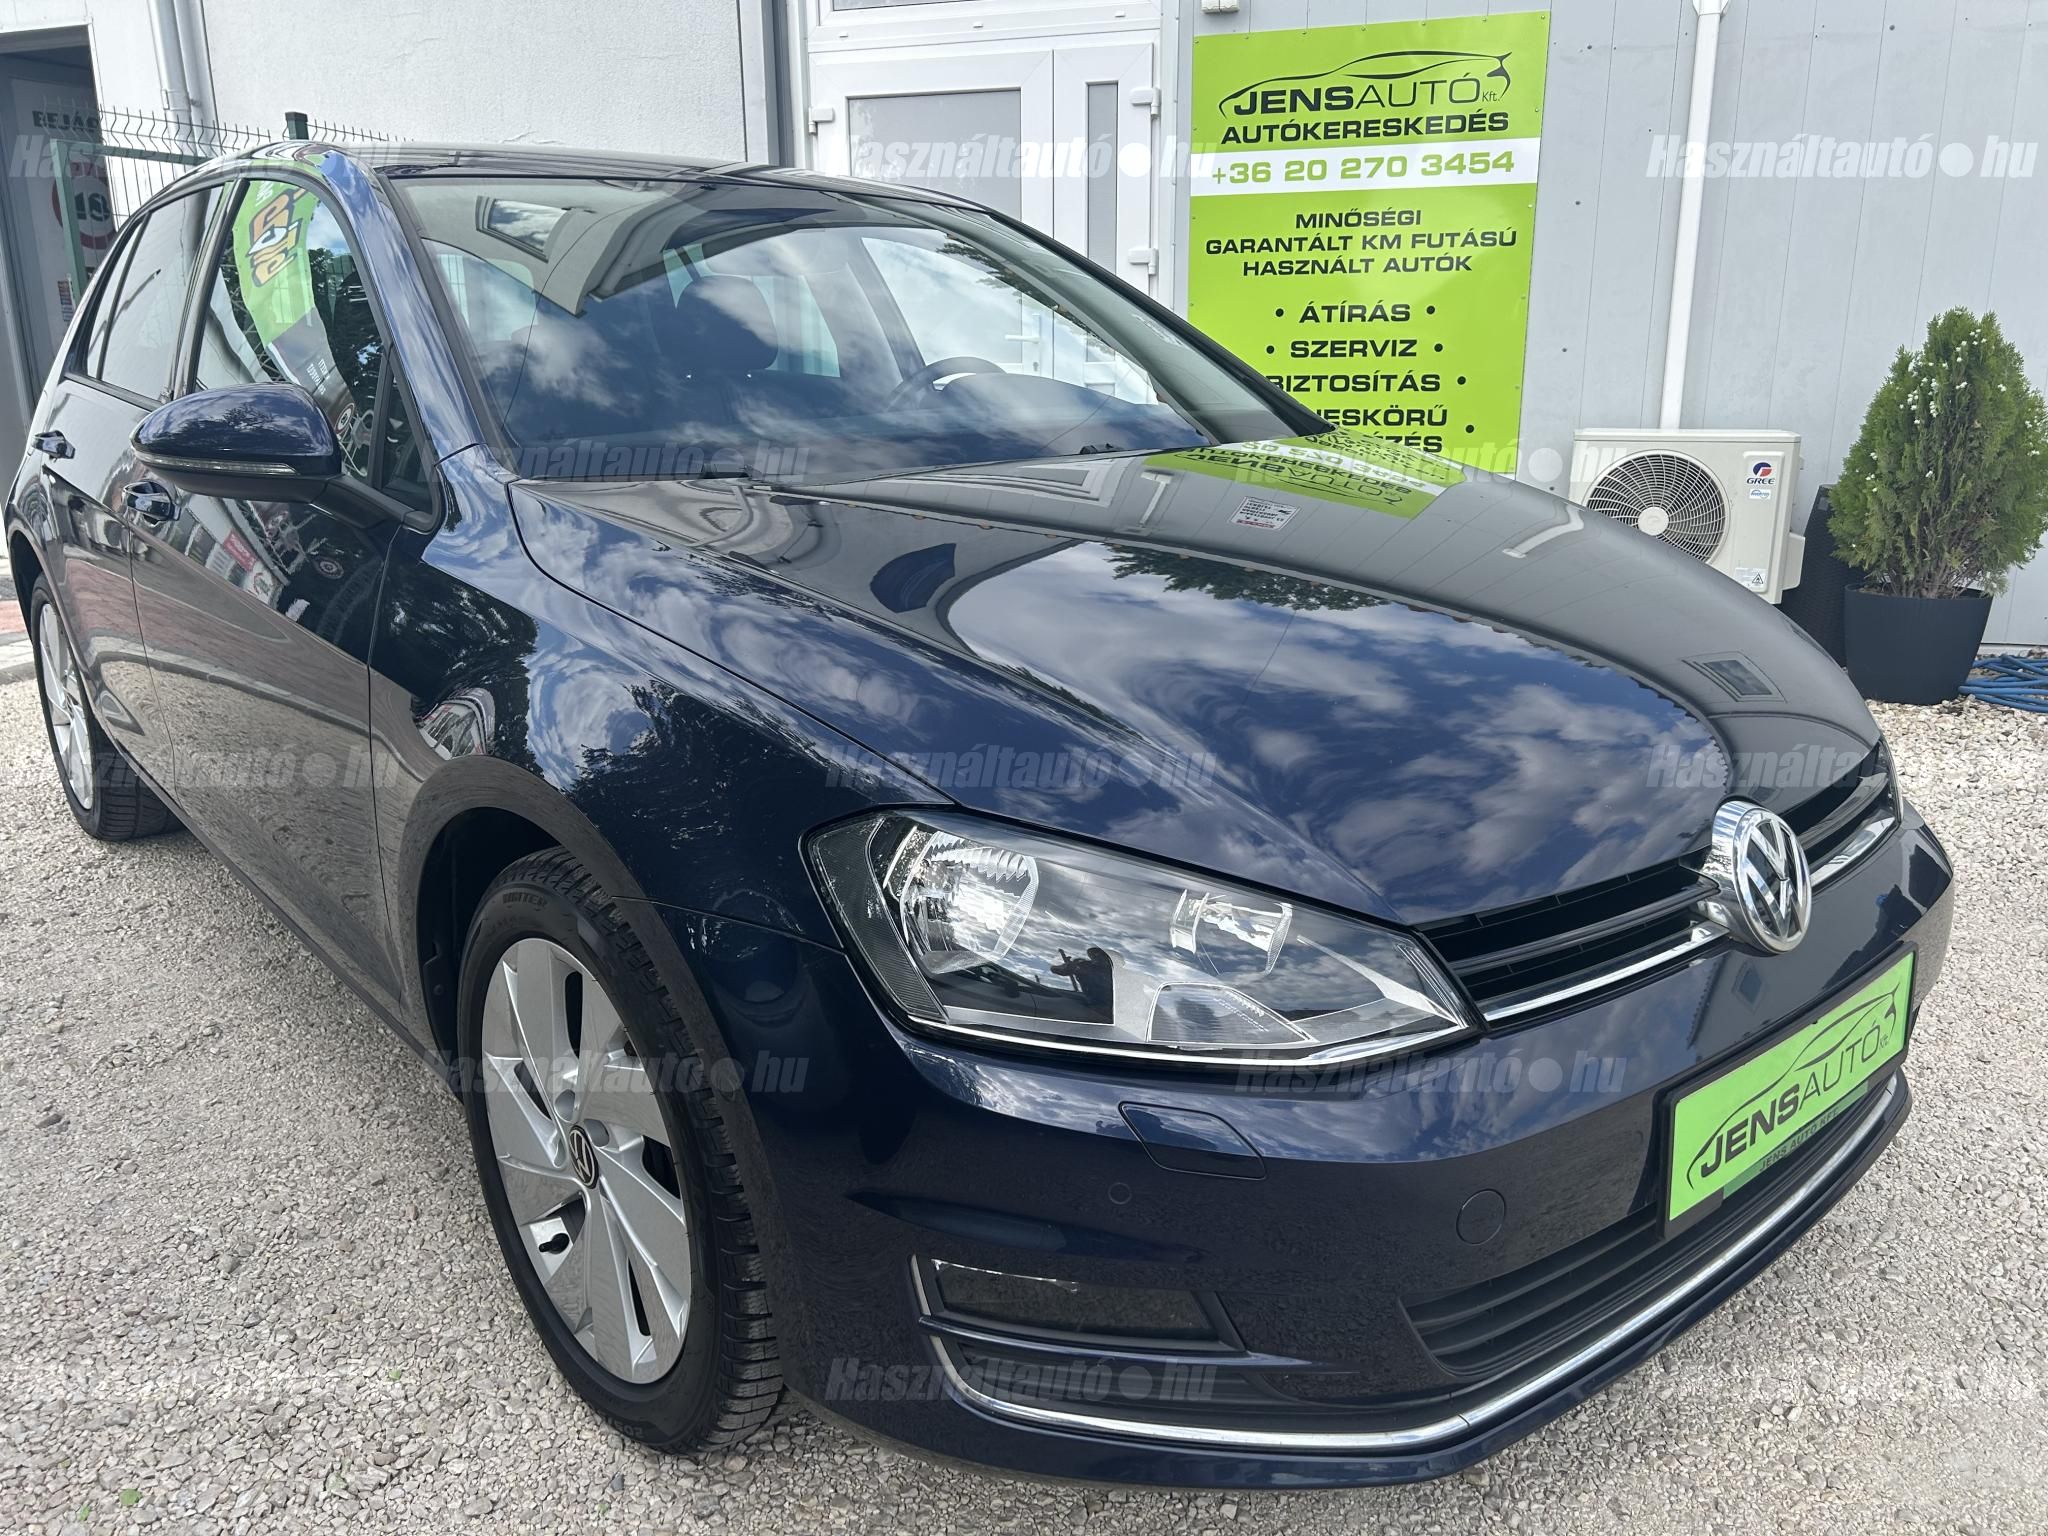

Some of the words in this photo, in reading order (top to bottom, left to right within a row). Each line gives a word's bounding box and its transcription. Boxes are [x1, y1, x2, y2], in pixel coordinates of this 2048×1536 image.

[1233, 72, 1481, 116] JENSAUTÓ
[1221, 109, 1510, 145] AUTÓKERESKEDÉS
[1212, 161, 1272, 185] +36
[1284, 159, 1327, 182] 20
[1340, 155, 1408, 180] 270
[1421, 151, 1515, 176] 3454
[1295, 207, 1422, 229] MINŐSÉGI
[1206, 233, 1353, 255] GARANTÁLT
[1361, 234, 1402, 250] KM
[1411, 227, 1518, 249] FUTÁSÚ
[1243, 255, 1375, 277] HASZNÁLT
[1383, 251, 1473, 273] AUTÓK
[1299, 299, 1411, 324] ÁTÍRÁS
[1290, 339, 1417, 359] SZERVIZ
[1700, 1020, 1881, 1179] JENSAUTÓ
